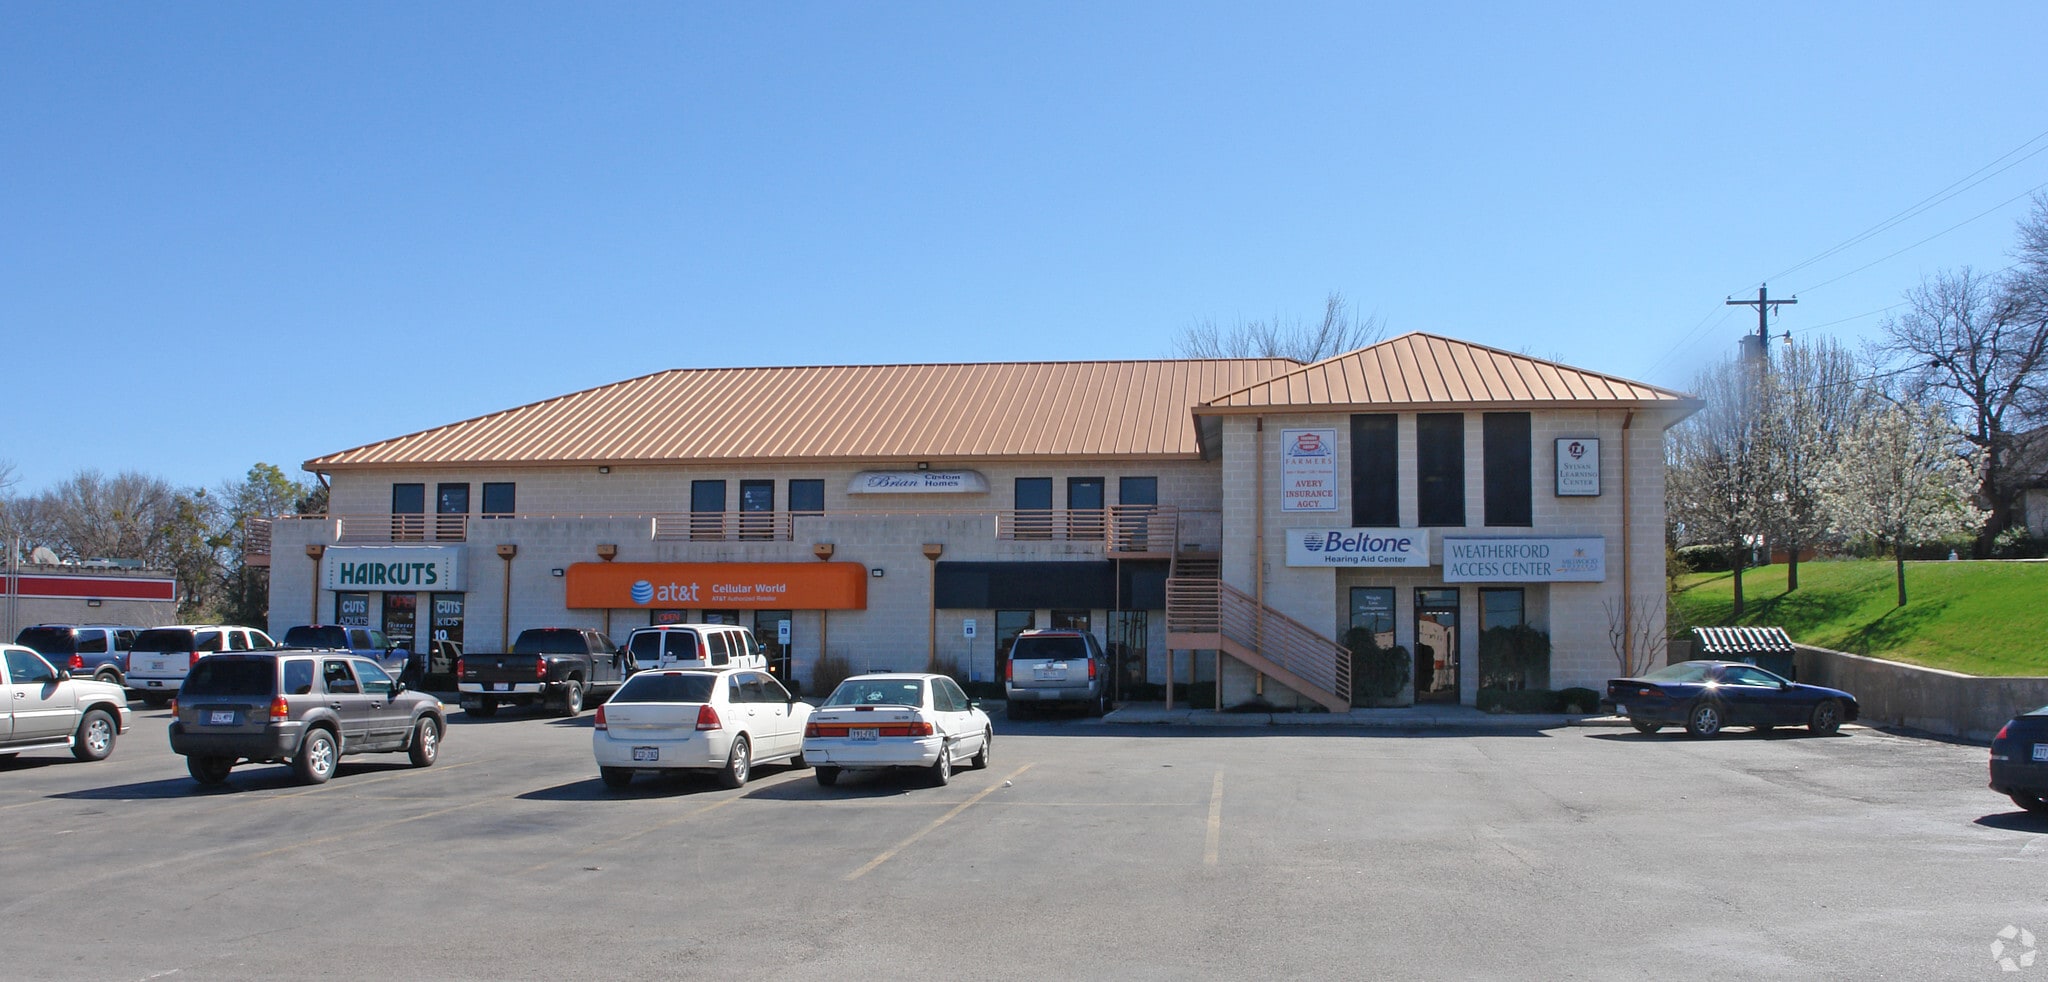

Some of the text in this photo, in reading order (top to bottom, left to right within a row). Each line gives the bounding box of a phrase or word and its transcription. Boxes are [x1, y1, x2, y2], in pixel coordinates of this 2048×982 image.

[868, 474, 918, 488] Brian
[1286, 490, 1334, 498] INSURANCE
[1324, 531, 1412, 552] Beltone
[1452, 544, 1550, 558] WEATHERFORD
[1325, 556, 1358, 564] Hearing
[340, 562, 438, 585] HAIRCUTS
[1450, 562, 1552, 576] ACCESS CENTER
[656, 582, 700, 602] at&t
[712, 584, 786, 593] Cellular World
[342, 600, 366, 613] CUTS
[436, 602, 460, 614] CUTS
[340, 616, 368, 626] ADULTS
[438, 618, 459, 626] KIDS
[658, 613, 680, 622] OPEN
